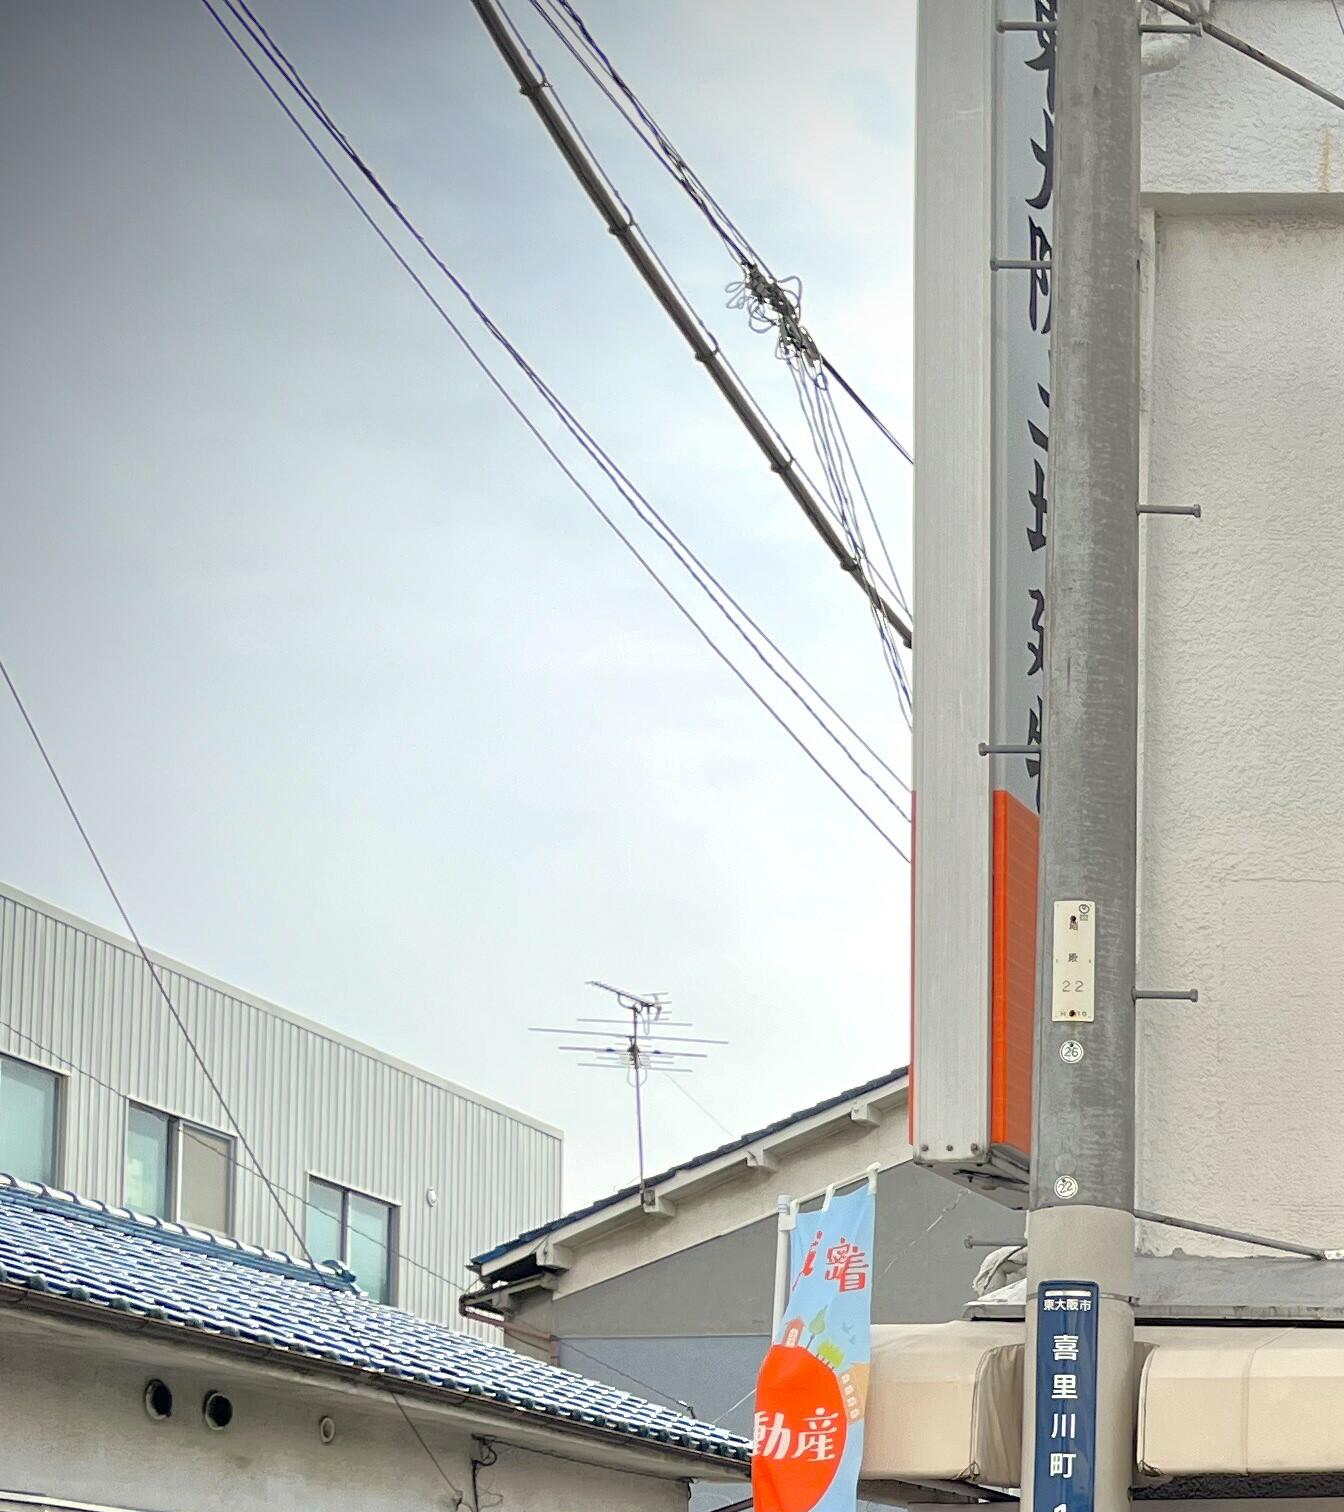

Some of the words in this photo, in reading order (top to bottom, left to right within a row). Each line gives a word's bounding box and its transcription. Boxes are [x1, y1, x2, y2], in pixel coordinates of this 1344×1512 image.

[1062, 980, 1085, 993] 22
[1064, 1047, 1079, 1058] 26
[1058, 1182, 1073, 1194] 22
[1044, 1299, 1092, 1312] 東大阪市
